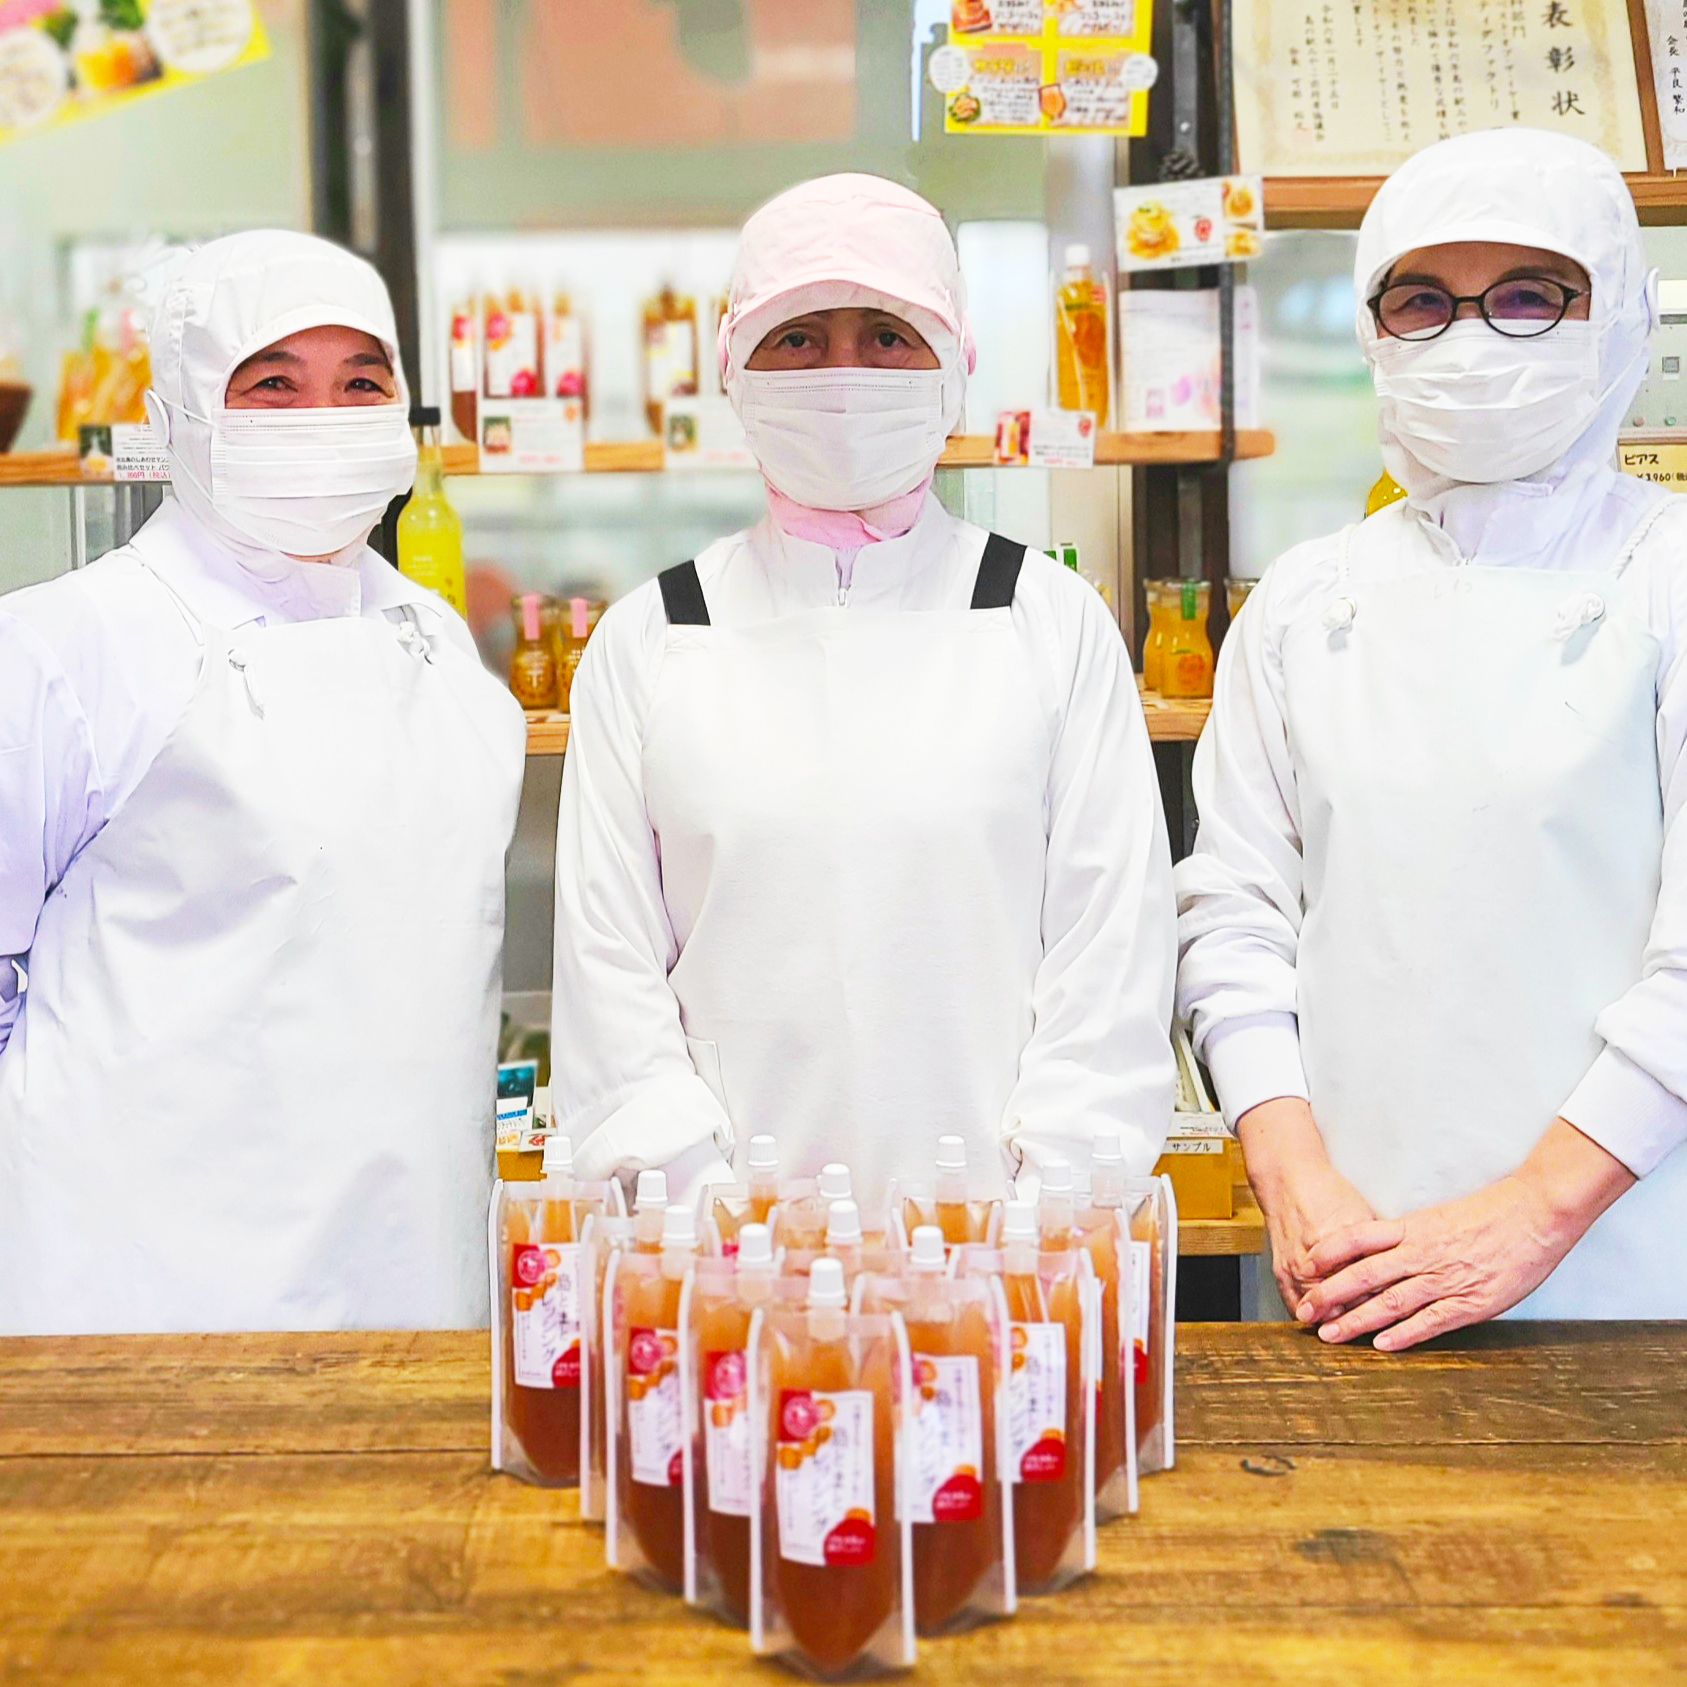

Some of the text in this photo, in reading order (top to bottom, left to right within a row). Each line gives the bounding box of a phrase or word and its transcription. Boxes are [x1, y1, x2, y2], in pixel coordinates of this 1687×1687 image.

[1541, 0, 1586, 116] 表彰状
[1172, 1141, 1212, 1152] サンプル
